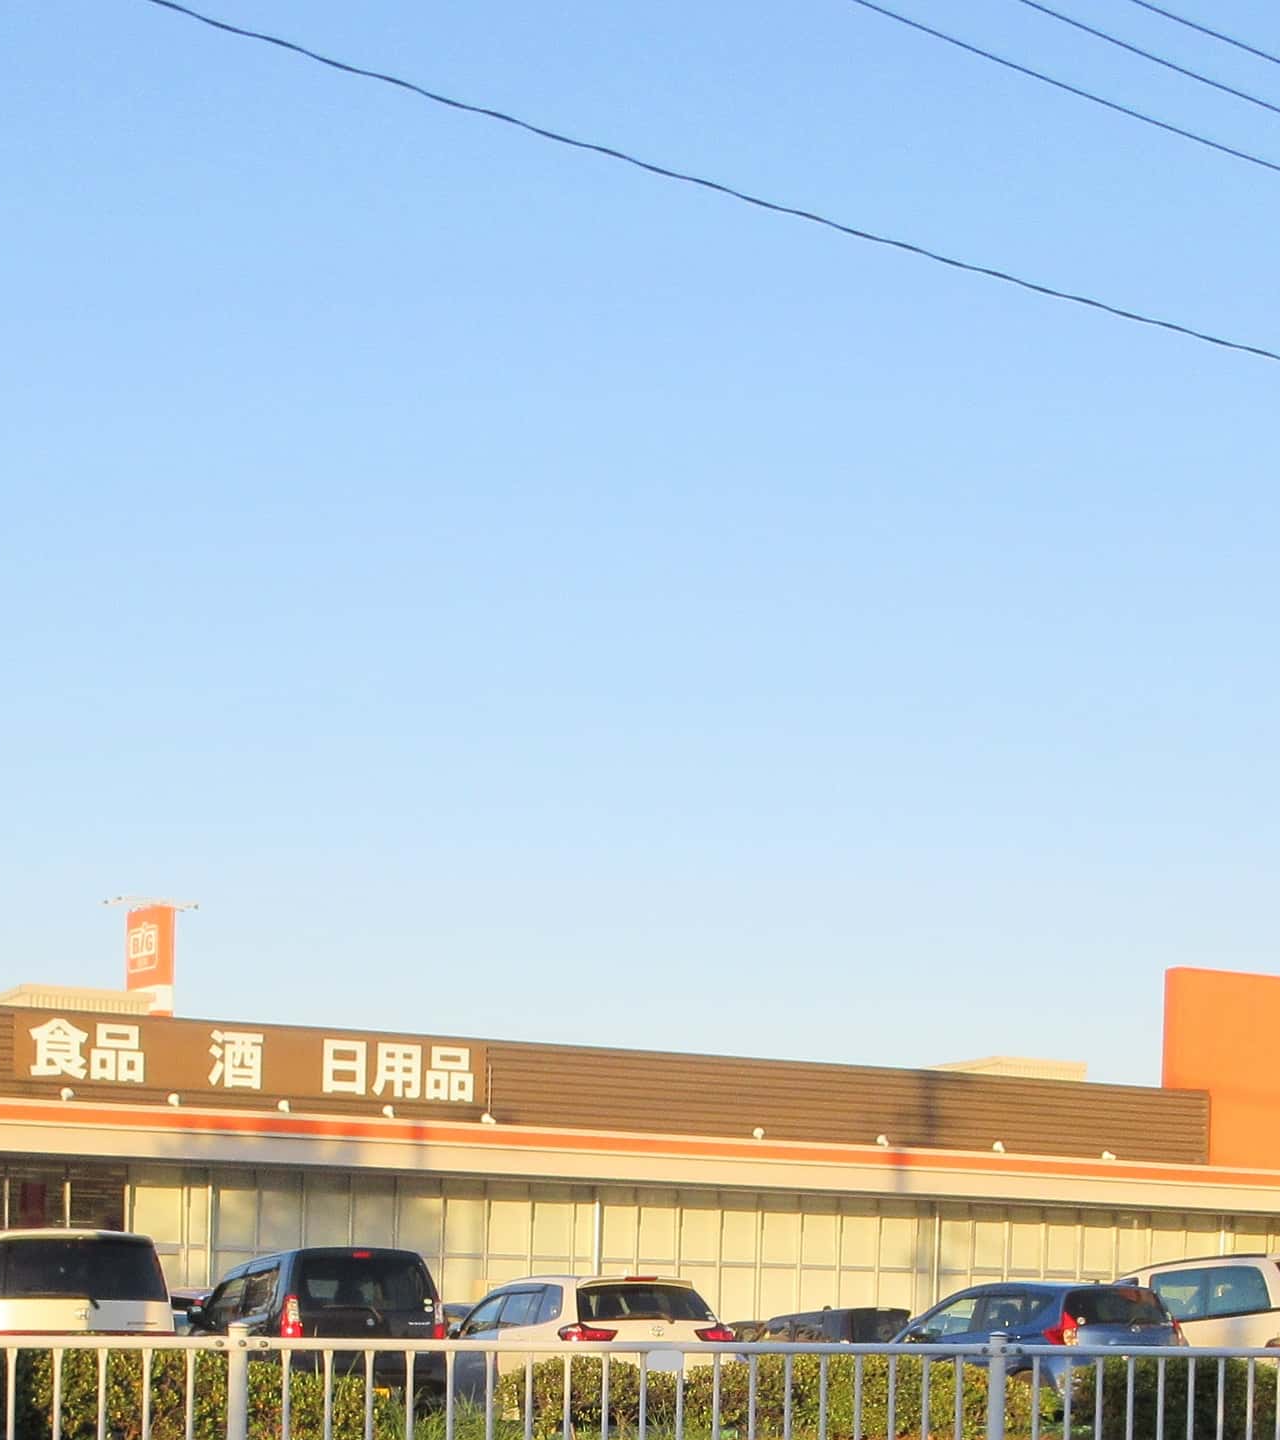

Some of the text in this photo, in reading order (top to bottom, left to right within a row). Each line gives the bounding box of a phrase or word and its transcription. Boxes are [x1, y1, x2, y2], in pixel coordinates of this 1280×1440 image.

[29, 1017, 474, 1102] 食品 酒 日用品
